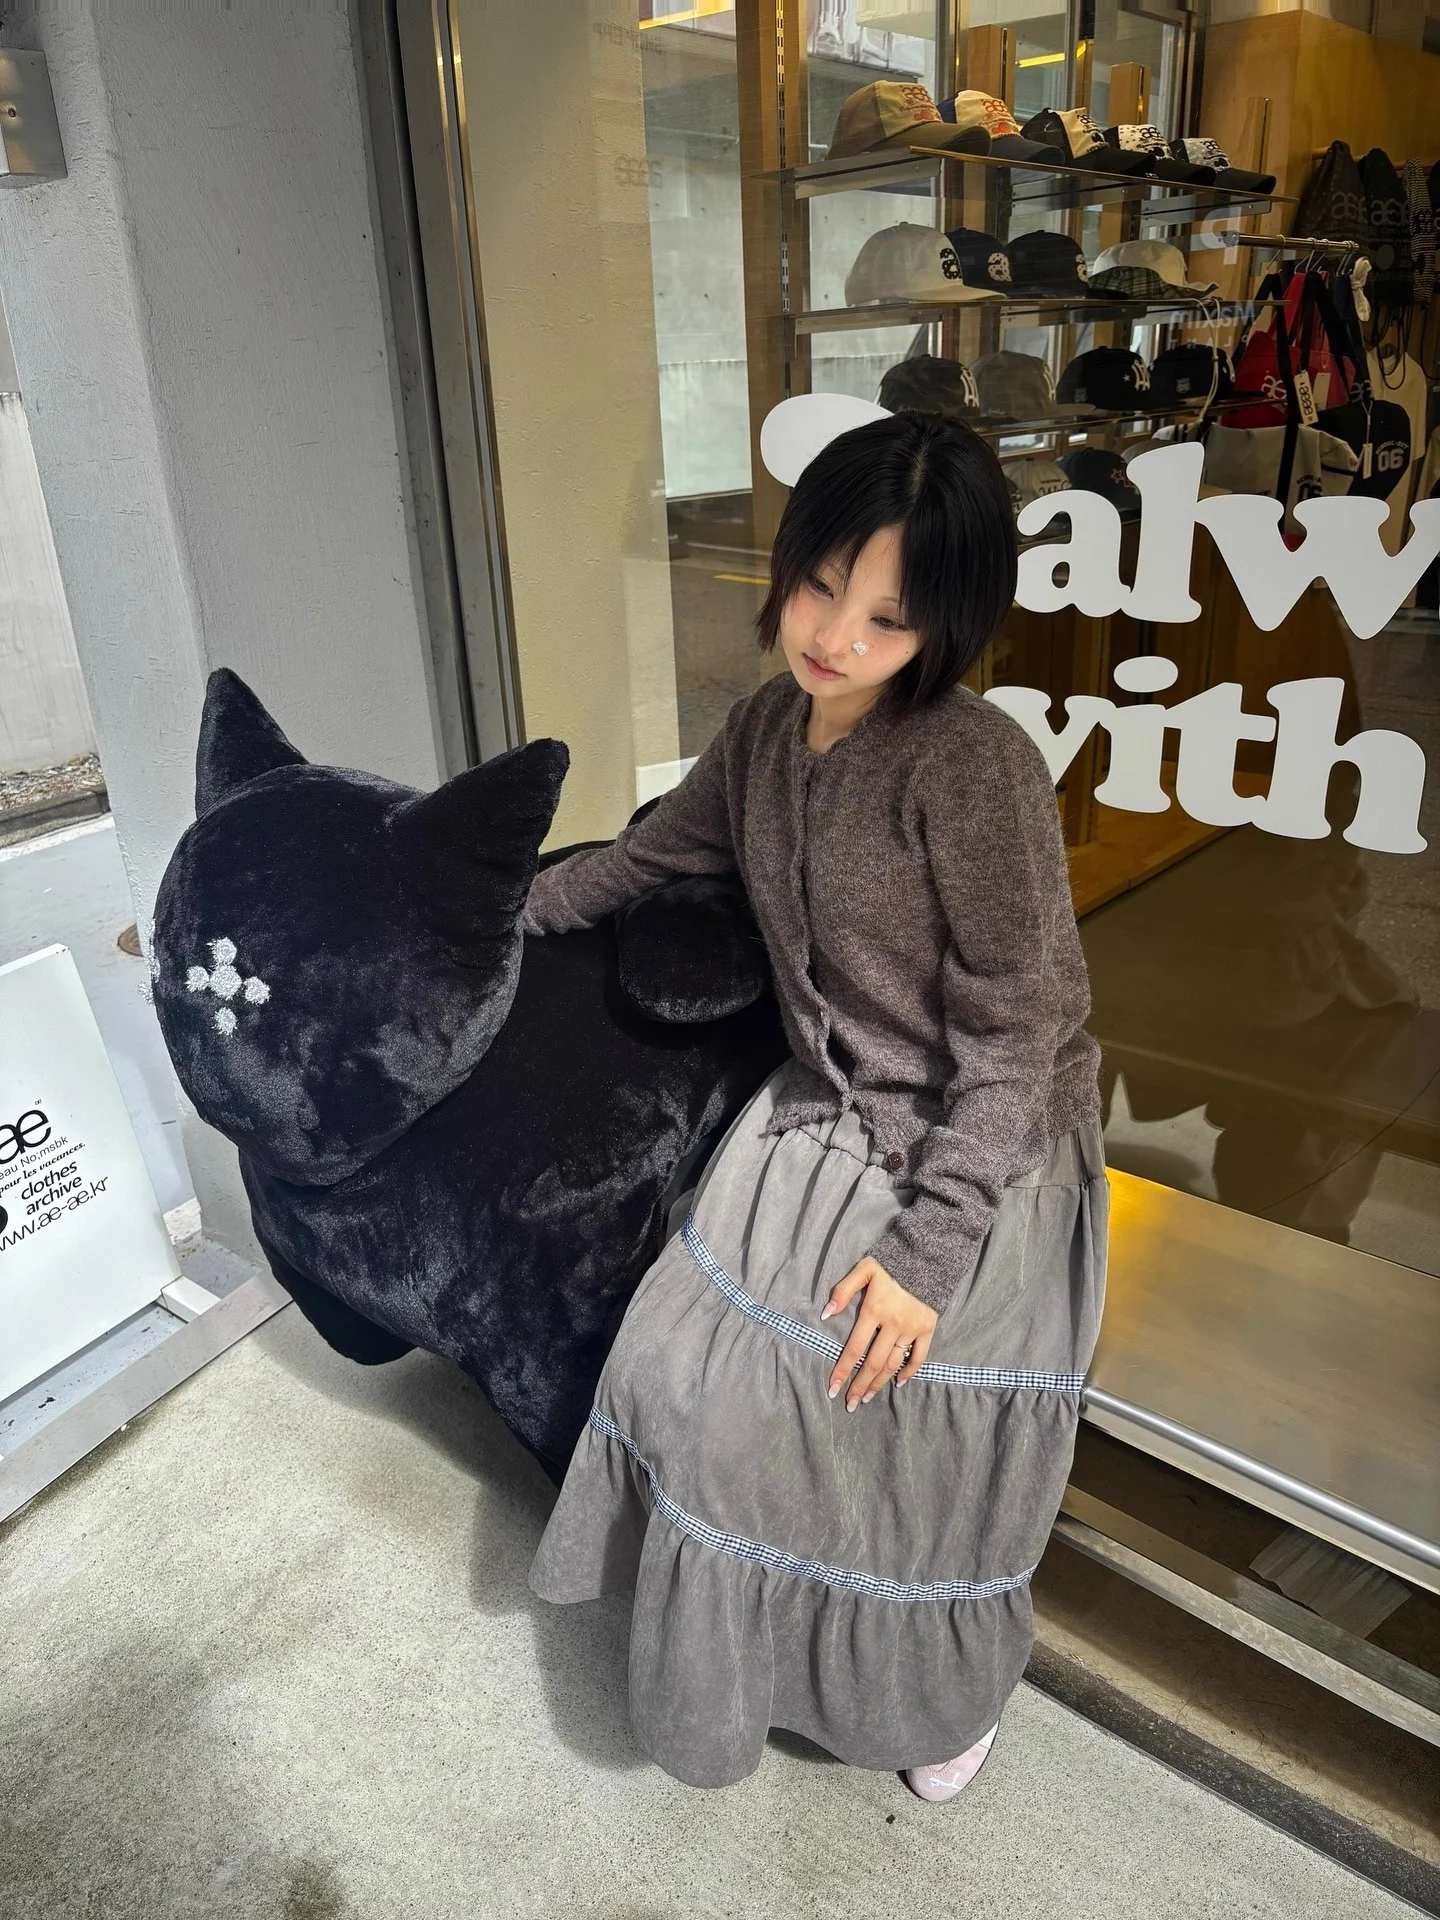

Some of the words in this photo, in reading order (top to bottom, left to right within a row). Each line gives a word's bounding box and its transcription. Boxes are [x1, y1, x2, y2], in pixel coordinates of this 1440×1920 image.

[987, 252, 1012, 282] a
[1377, 448, 1405, 473] 06
[23, 1168, 38, 1180] les
[39, 1142, 86, 1172] vacances.
[21, 1160, 78, 1201] clothes
[26, 1175, 82, 1216] archive
